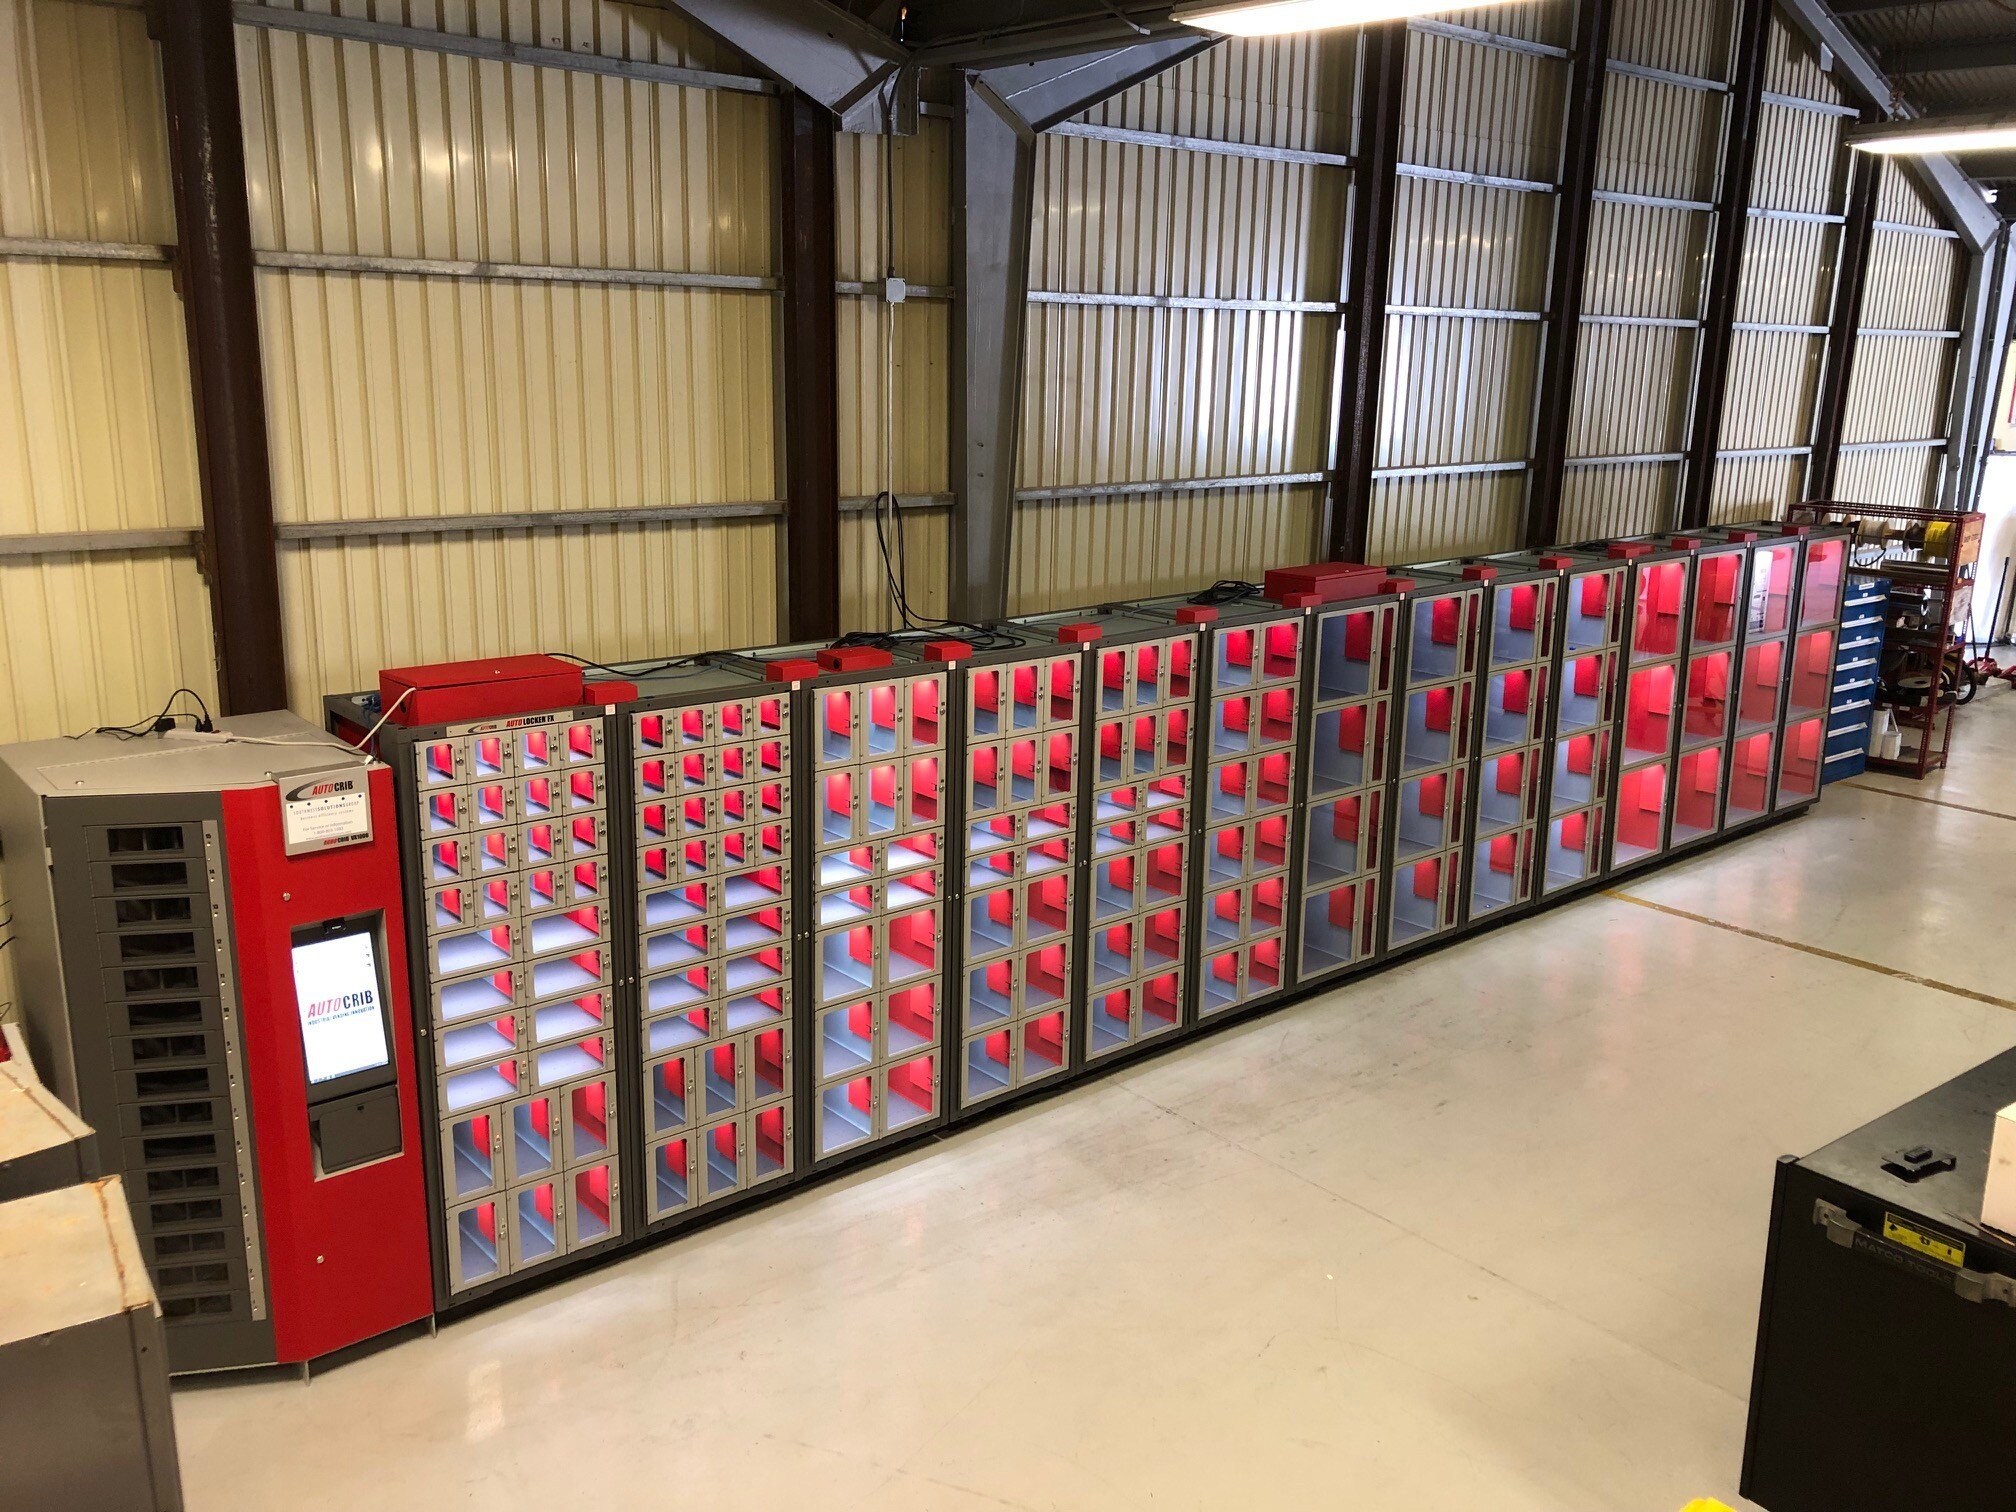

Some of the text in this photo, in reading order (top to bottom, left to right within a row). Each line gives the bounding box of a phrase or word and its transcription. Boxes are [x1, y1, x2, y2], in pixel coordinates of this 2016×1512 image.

[547, 714, 554, 722] FX
[312, 780, 354, 796] AUTOCRIB
[308, 990, 373, 1018] AUTOCRIB
